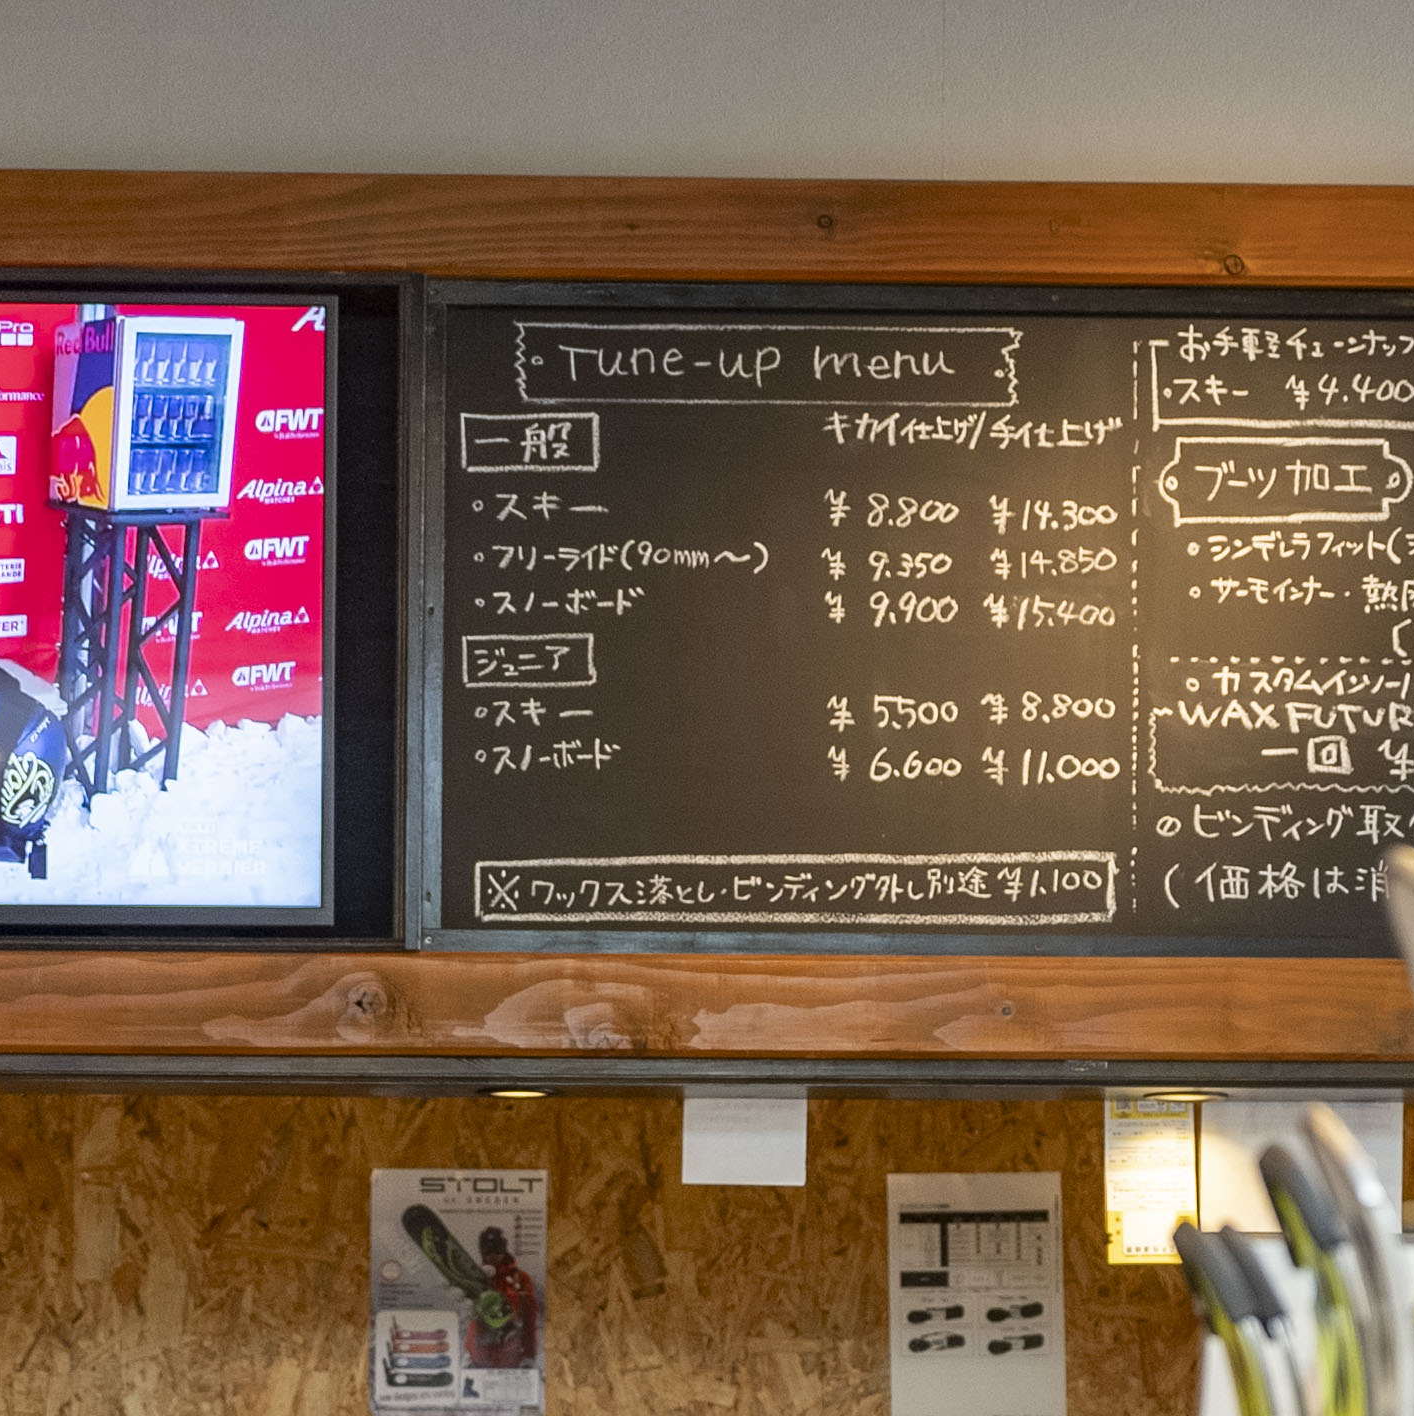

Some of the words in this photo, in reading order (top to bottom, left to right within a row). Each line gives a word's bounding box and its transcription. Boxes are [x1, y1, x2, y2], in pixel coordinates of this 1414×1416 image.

[558, 343, 782, 389] Tune-up
[814, 345, 956, 380] menu
[1172, 374, 1250, 405] スキー
[474, 421, 573, 462] 一般
[237, 478, 307, 500] Alpina
[494, 492, 610, 521] スキー
[264, 536, 309, 560] FWT
[492, 587, 646, 616] スノーボード
[226, 609, 293, 632] Alpina
[474, 645, 572, 678] ジュニア
[493, 699, 594, 727] スキー
[1178, 700, 1280, 730] WAX
[493, 737, 622, 775] スノーボード
[419, 1177, 543, 1193] STOLT
